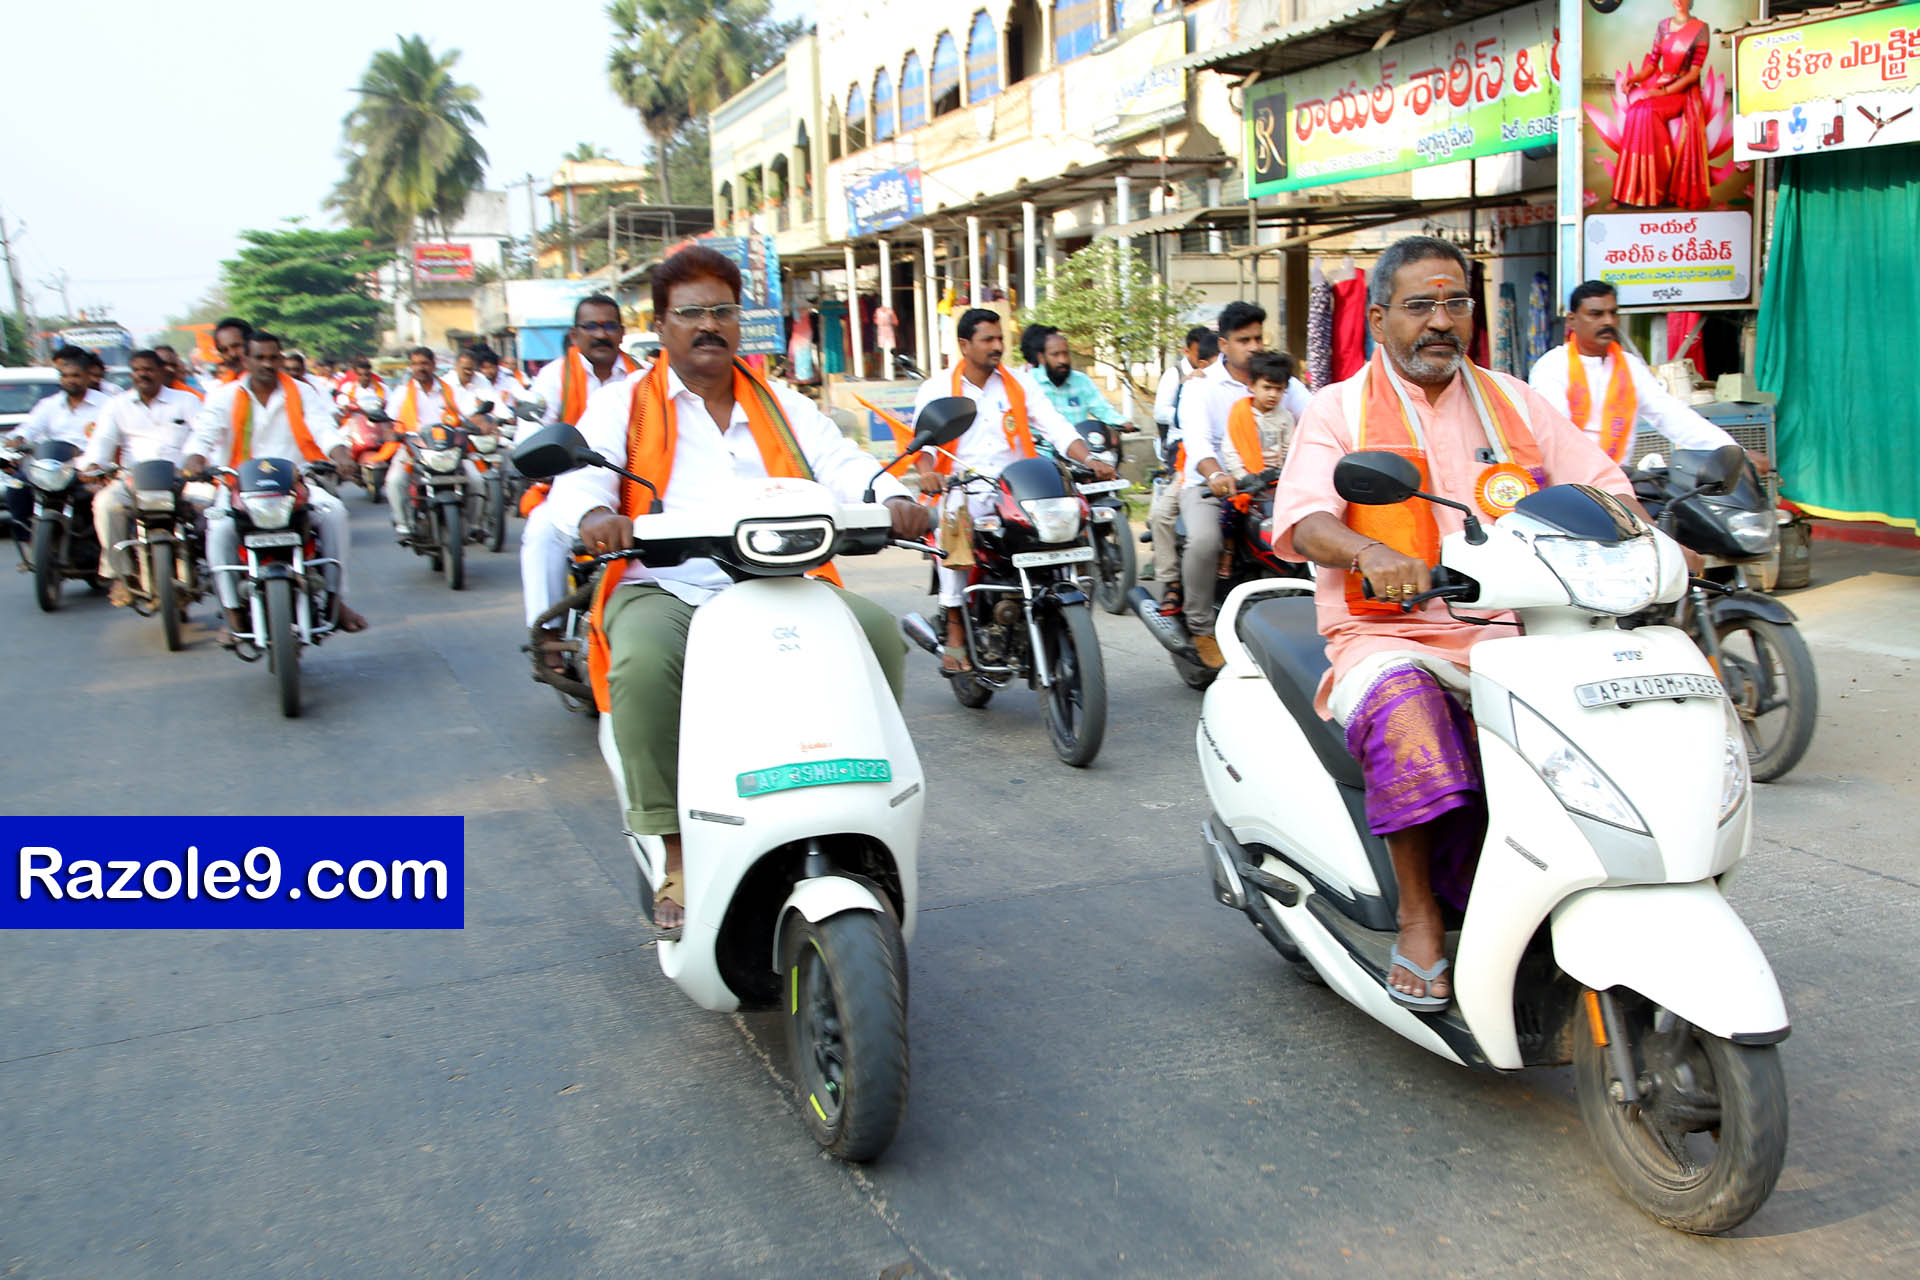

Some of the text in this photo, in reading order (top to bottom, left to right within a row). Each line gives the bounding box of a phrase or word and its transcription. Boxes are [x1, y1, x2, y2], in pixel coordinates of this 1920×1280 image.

[1295, 61, 1398, 142] రాయల్
[1403, 37, 1505, 116] శారీస్
[1513, 49, 1538, 93] &
[1640, 217, 1699, 235] రాయల్
[1604, 243, 1656, 265] శారీస్
